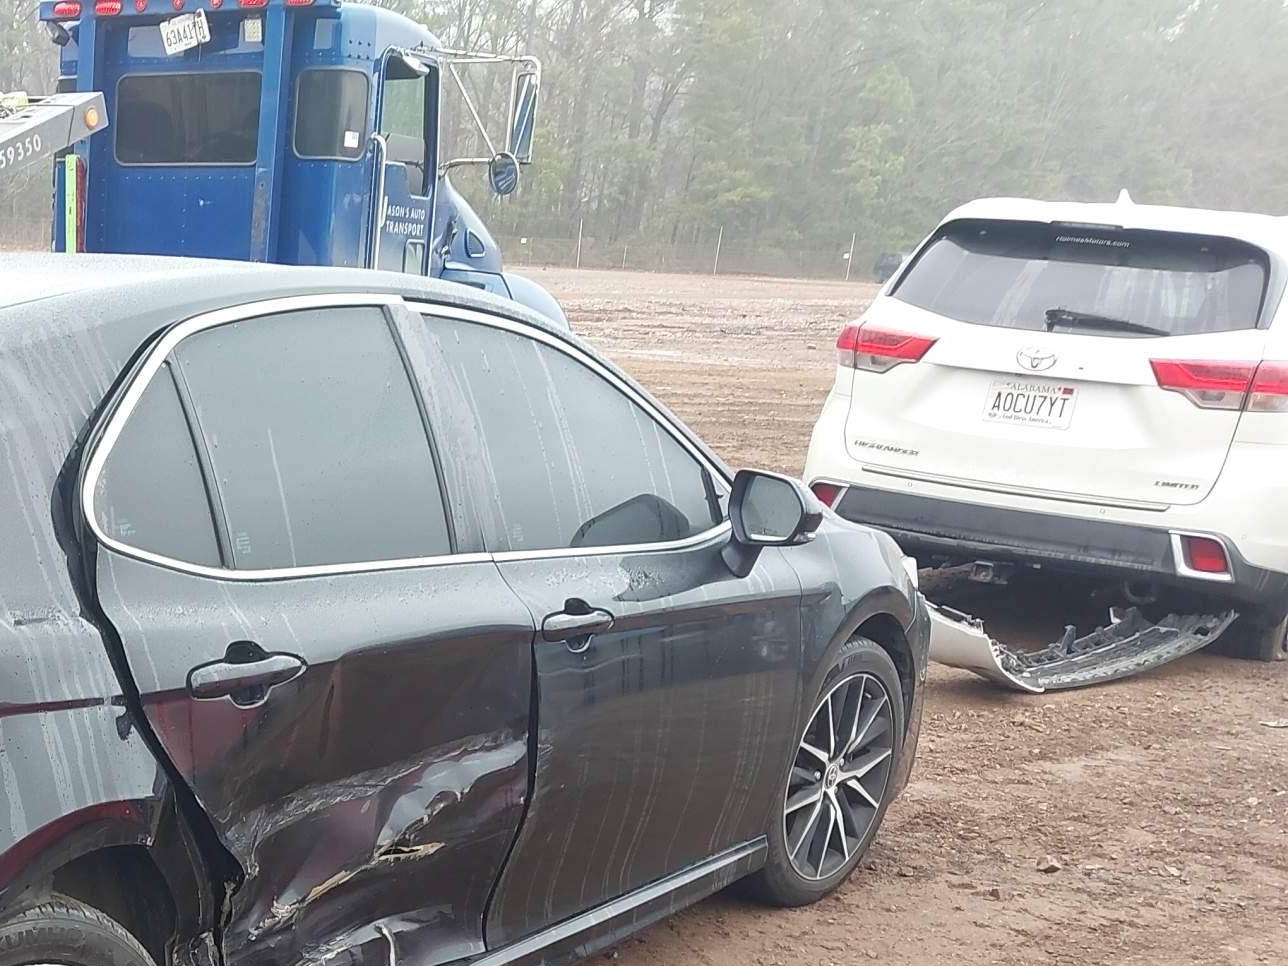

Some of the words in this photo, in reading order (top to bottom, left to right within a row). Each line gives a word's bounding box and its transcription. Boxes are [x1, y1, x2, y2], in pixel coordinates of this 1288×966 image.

[410, 207, 425, 220] AUTO
[385, 220, 424, 237] TRANSPORT
[1010, 382, 1056, 394] ALABAMA
